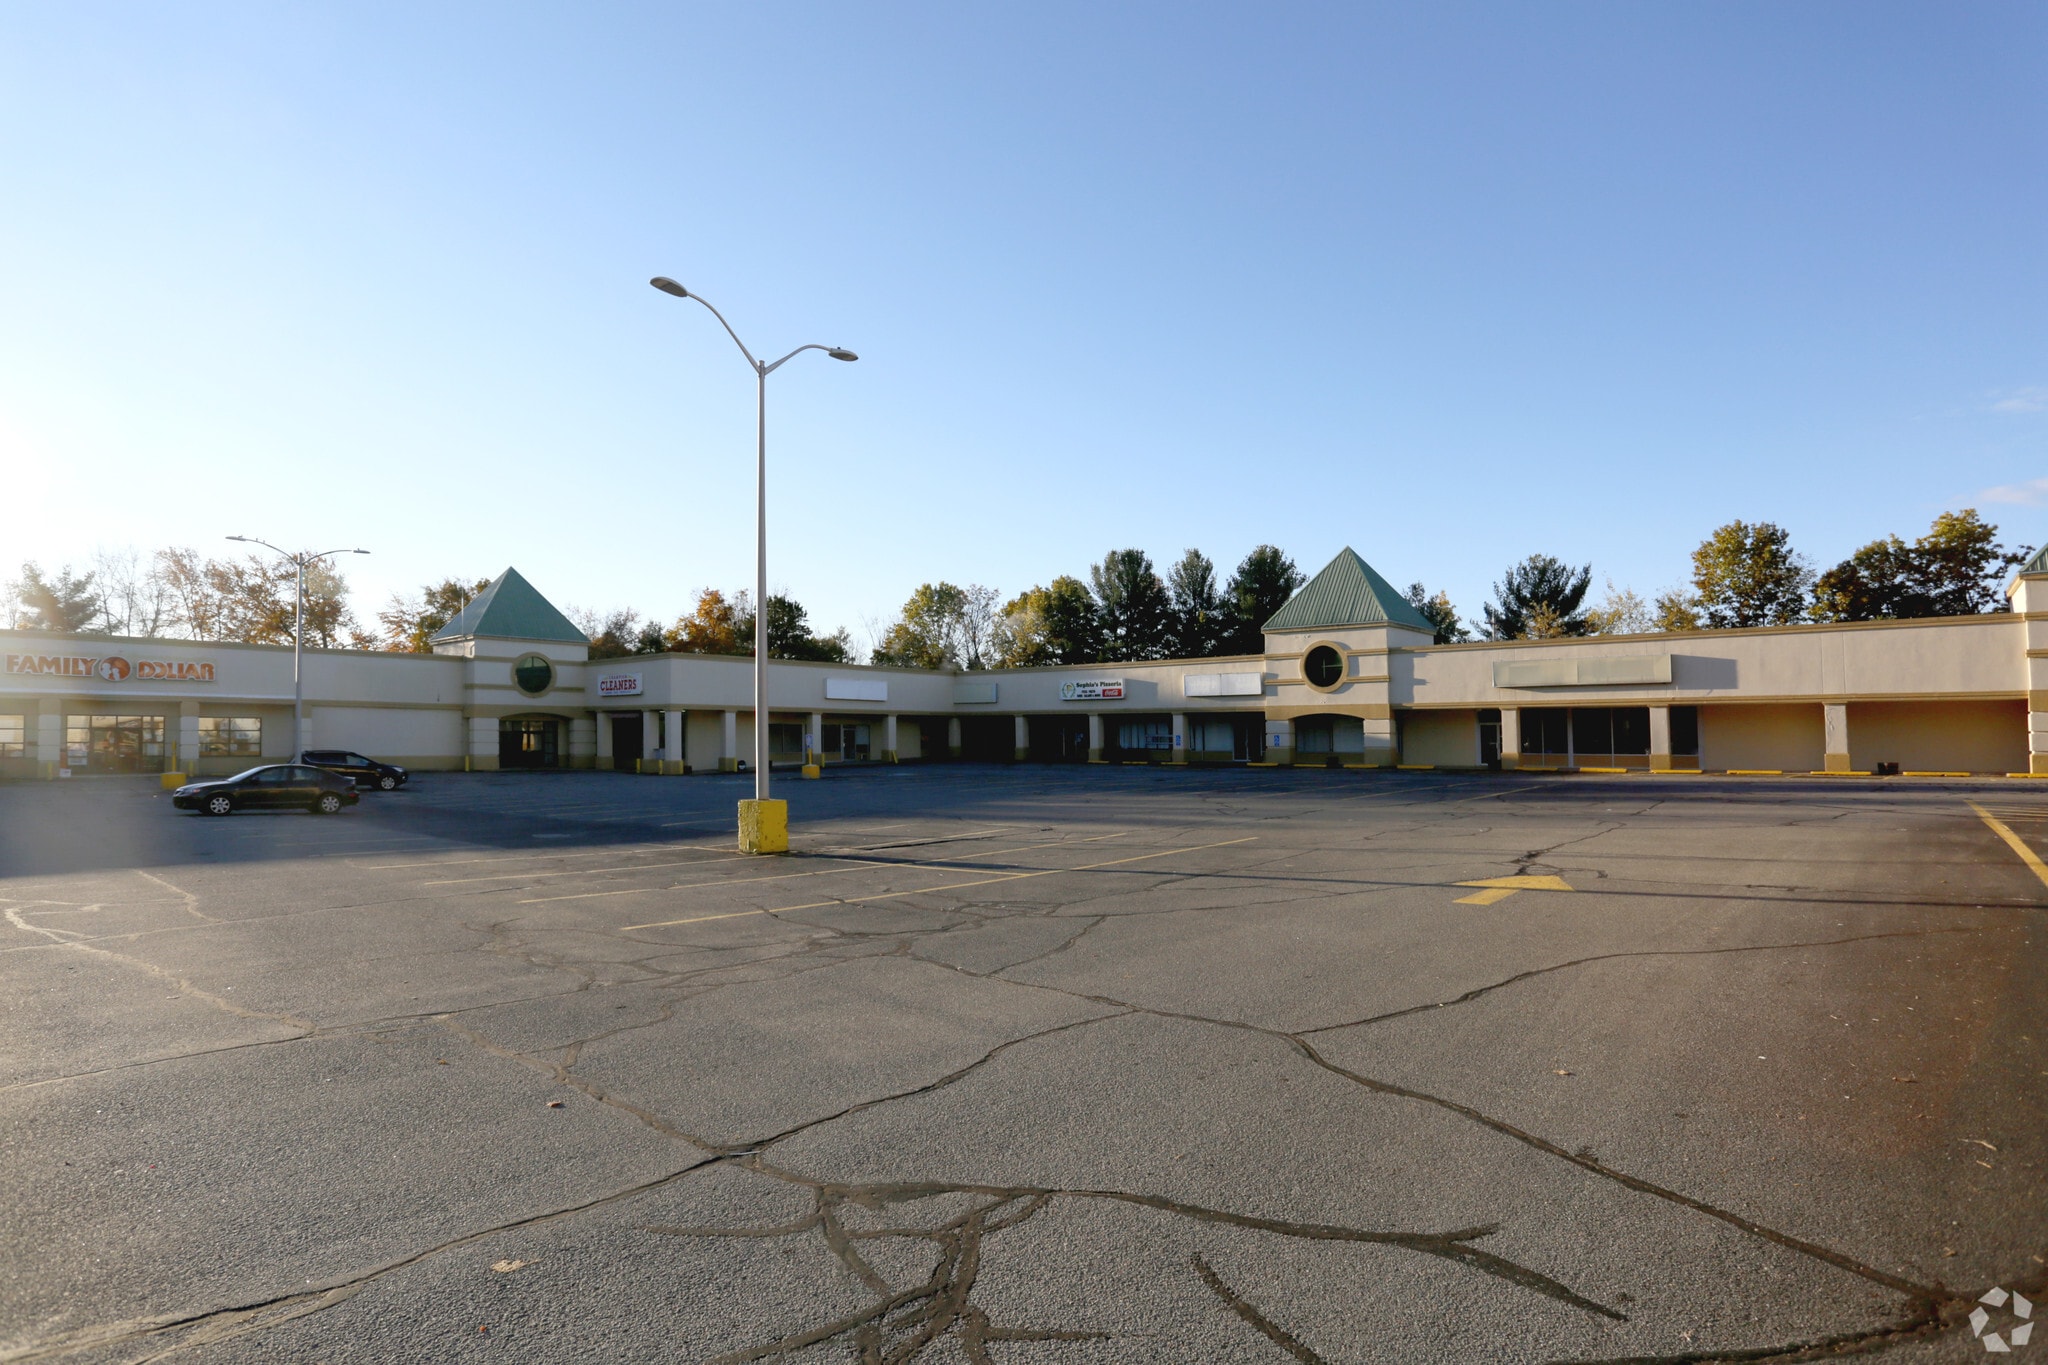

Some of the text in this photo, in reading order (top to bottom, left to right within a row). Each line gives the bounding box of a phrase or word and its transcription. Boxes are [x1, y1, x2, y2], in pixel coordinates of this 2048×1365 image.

[5, 654, 215, 681] FAMILY DOLLAR
[600, 679, 637, 691] CLEANERS
